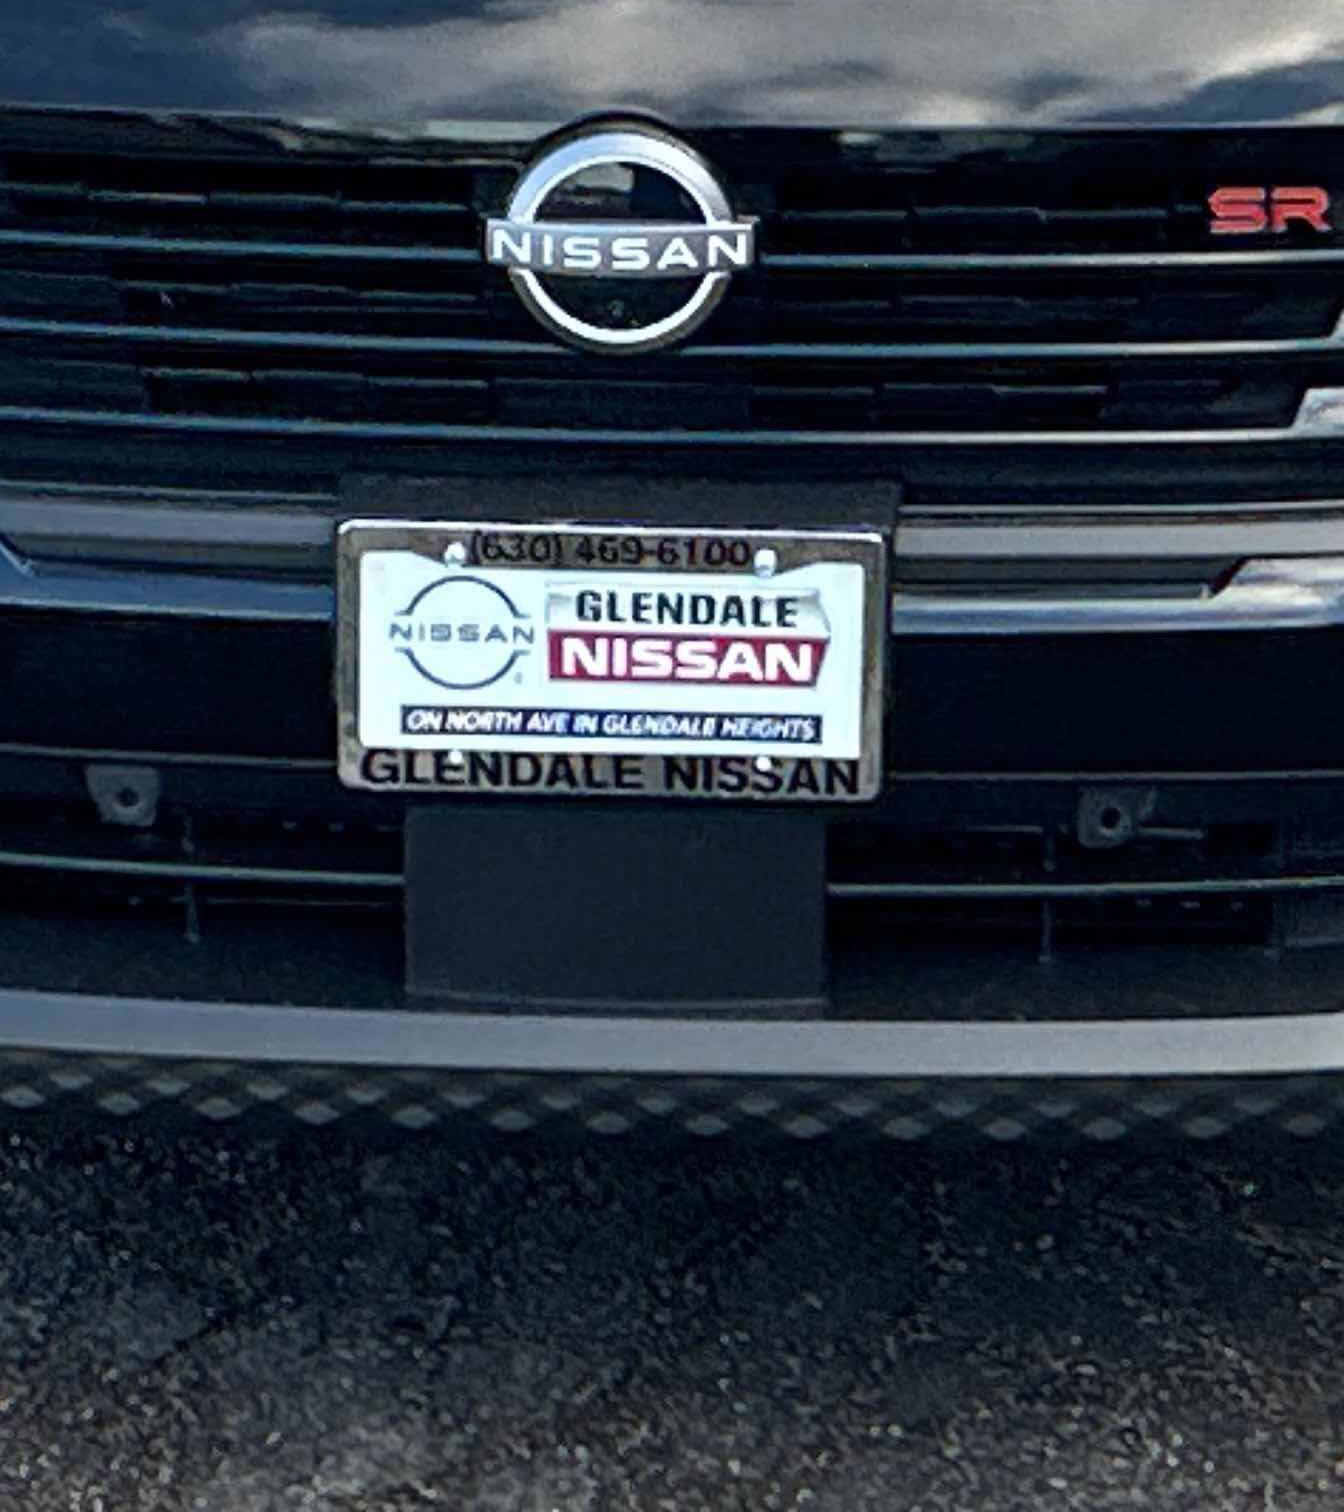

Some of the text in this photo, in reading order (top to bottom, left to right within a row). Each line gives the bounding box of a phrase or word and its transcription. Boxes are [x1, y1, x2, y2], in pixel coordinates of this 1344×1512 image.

[1208, 187, 1332, 234] SR
[491, 229, 748, 270] NISSAN
[468, 529, 752, 568] (630) 469-6100
[576, 589, 799, 629] GLENDALE
[388, 621, 535, 644] NISSAN
[560, 636, 814, 682] NISSAN
[407, 709, 815, 740] ON NORTH AVE IN GLENDALE HEIGHTS
[360, 747, 860, 795] GLENDALE NISSAN
